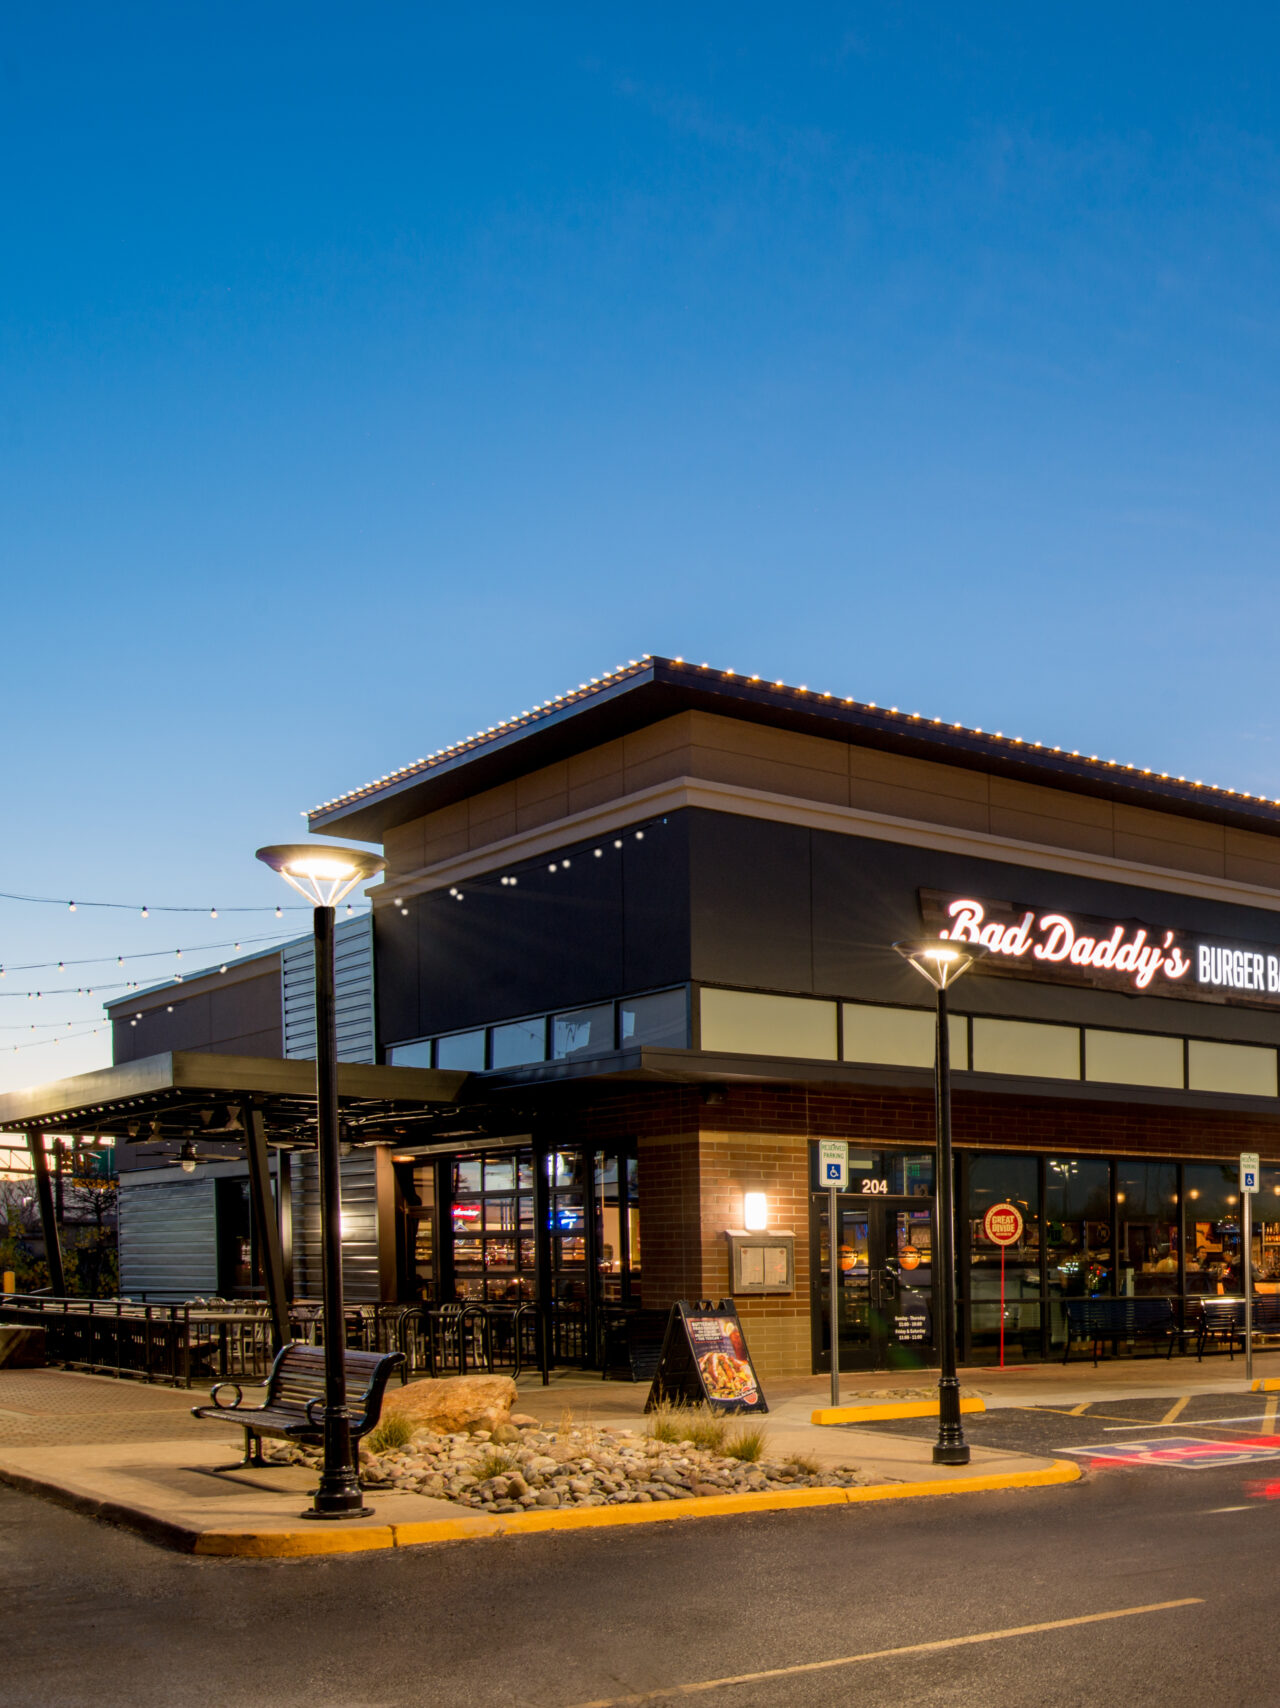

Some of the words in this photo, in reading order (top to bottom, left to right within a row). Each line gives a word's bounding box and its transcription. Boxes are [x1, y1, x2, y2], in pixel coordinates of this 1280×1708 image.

[939, 899, 1032, 956] Bad
[1034, 912, 1191, 989] Daddy's
[1198, 943, 1264, 991] BURGER
[861, 1178, 888, 1194] 204
[992, 1215, 1015, 1224] GREAT
[992, 1223, 1015, 1233] DIVIDE
